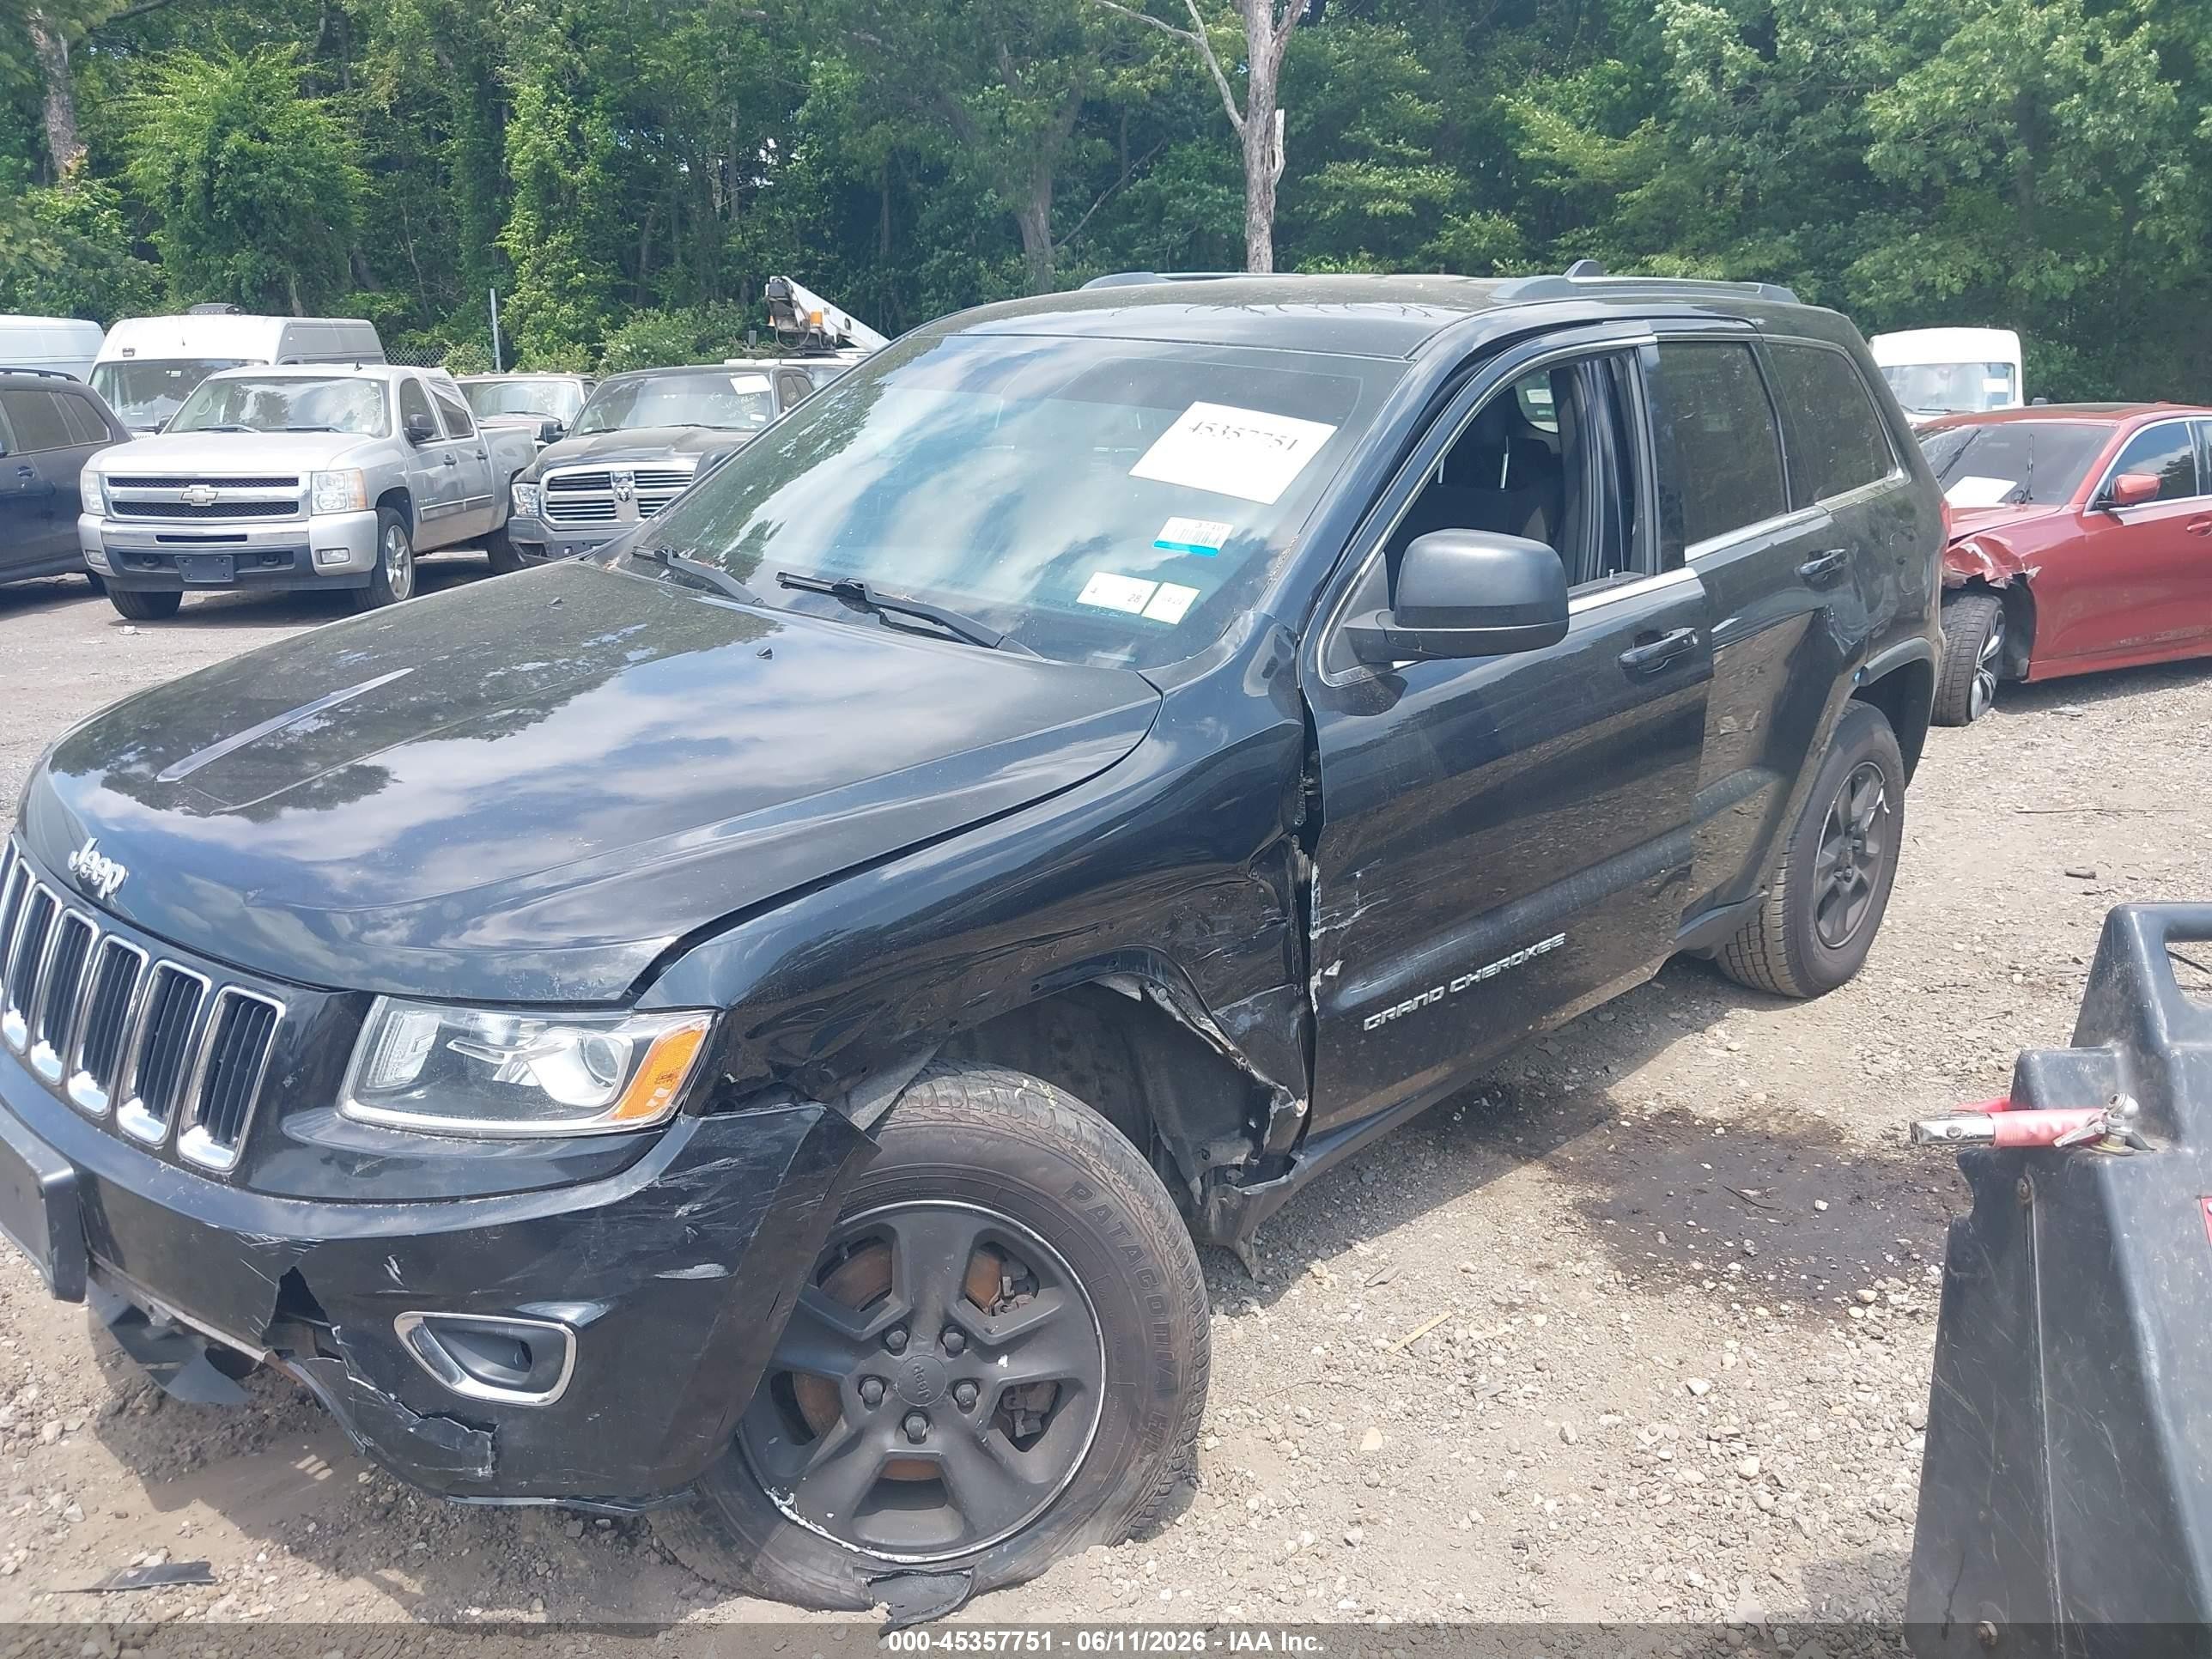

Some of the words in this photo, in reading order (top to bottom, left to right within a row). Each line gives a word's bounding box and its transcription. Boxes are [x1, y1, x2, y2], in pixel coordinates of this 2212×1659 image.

[68, 837, 127, 900] Jeep
[1364, 986, 1445, 1030] GRAND
[1449, 933, 1566, 994] CHEROKEE
[1064, 1180, 1179, 1396] PATAGONIA
[913, 1363, 932, 1399] Jeep
